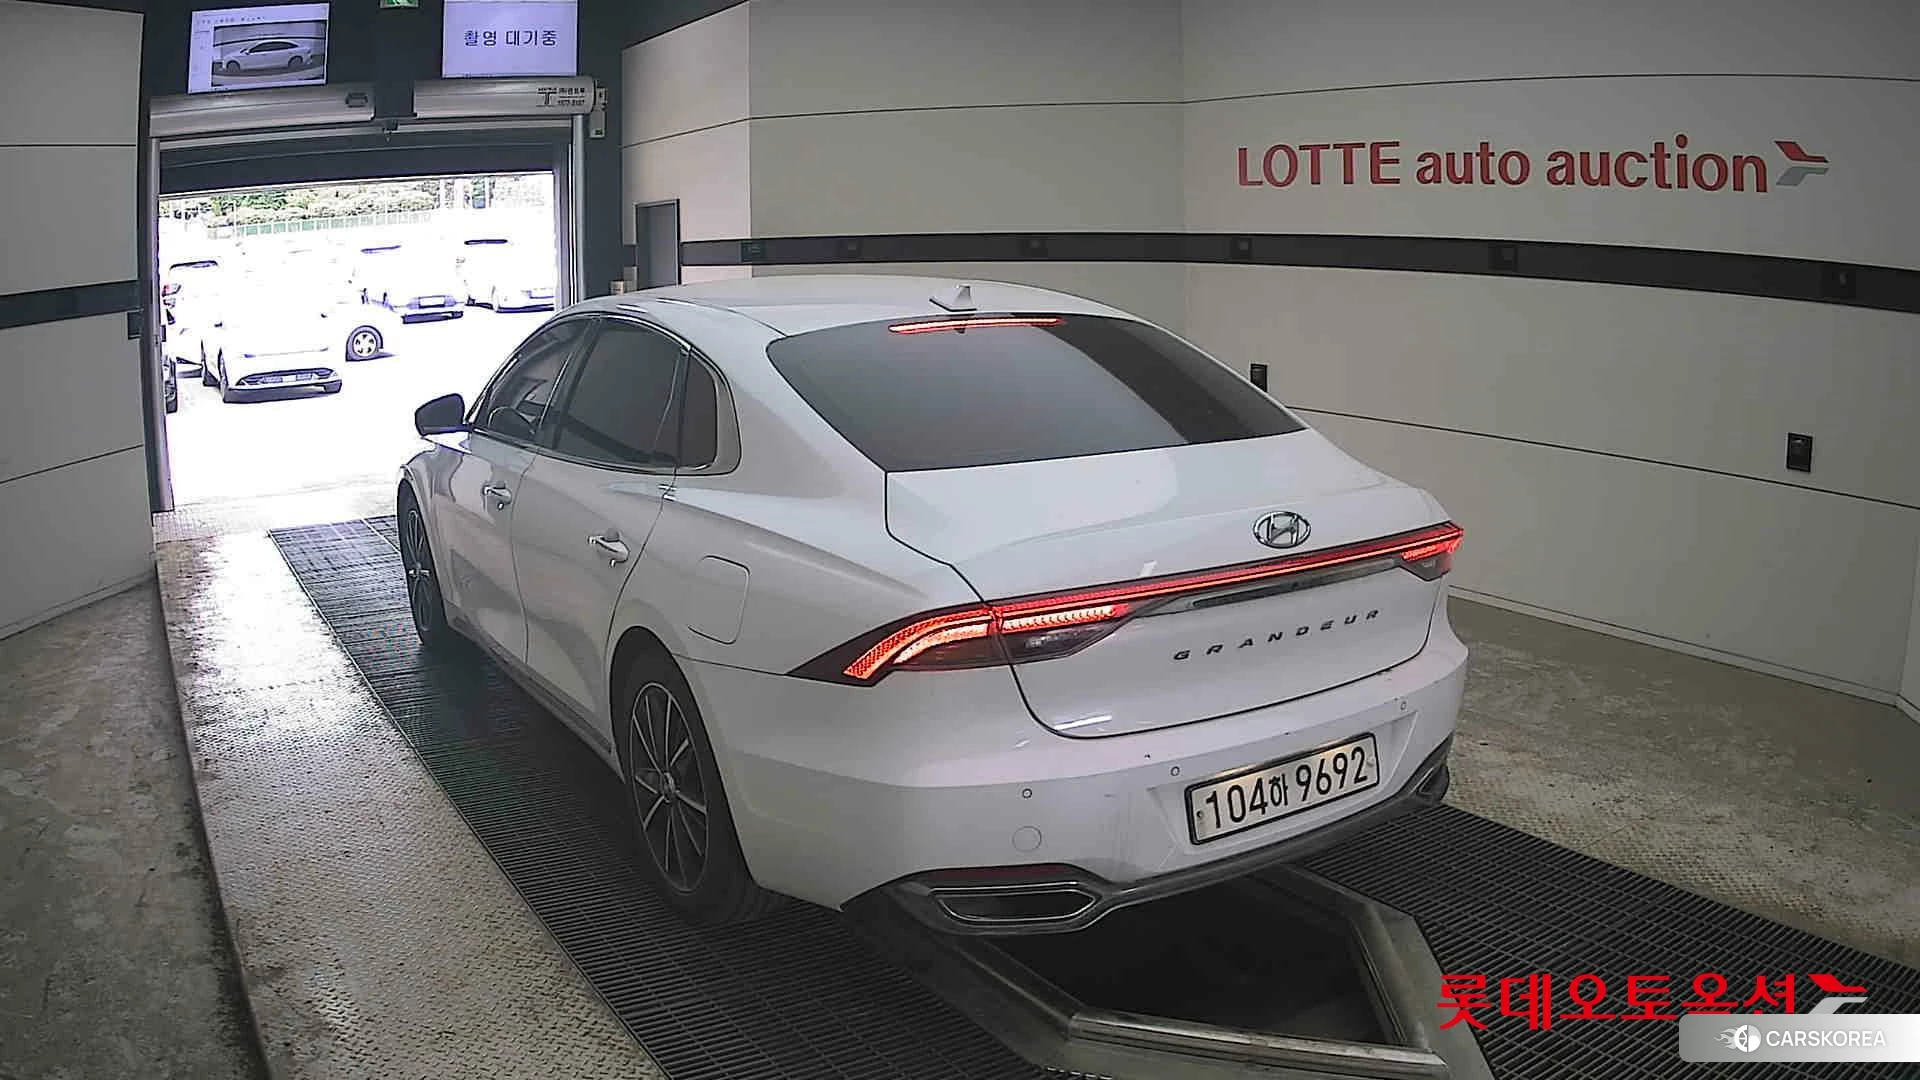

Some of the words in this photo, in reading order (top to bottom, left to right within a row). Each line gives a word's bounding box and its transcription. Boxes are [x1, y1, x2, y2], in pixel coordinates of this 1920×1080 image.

[464, 29, 497, 47] 촬영
[505, 29, 556, 47] 대기중
[1237, 141, 1400, 188] LOTTE
[1416, 141, 1530, 186] auto
[1546, 134, 1768, 193] auction
[1173, 608, 1380, 661] GRANDEUR
[1205, 772, 1289, 829] 104하
[1295, 746, 1368, 802] 9692
